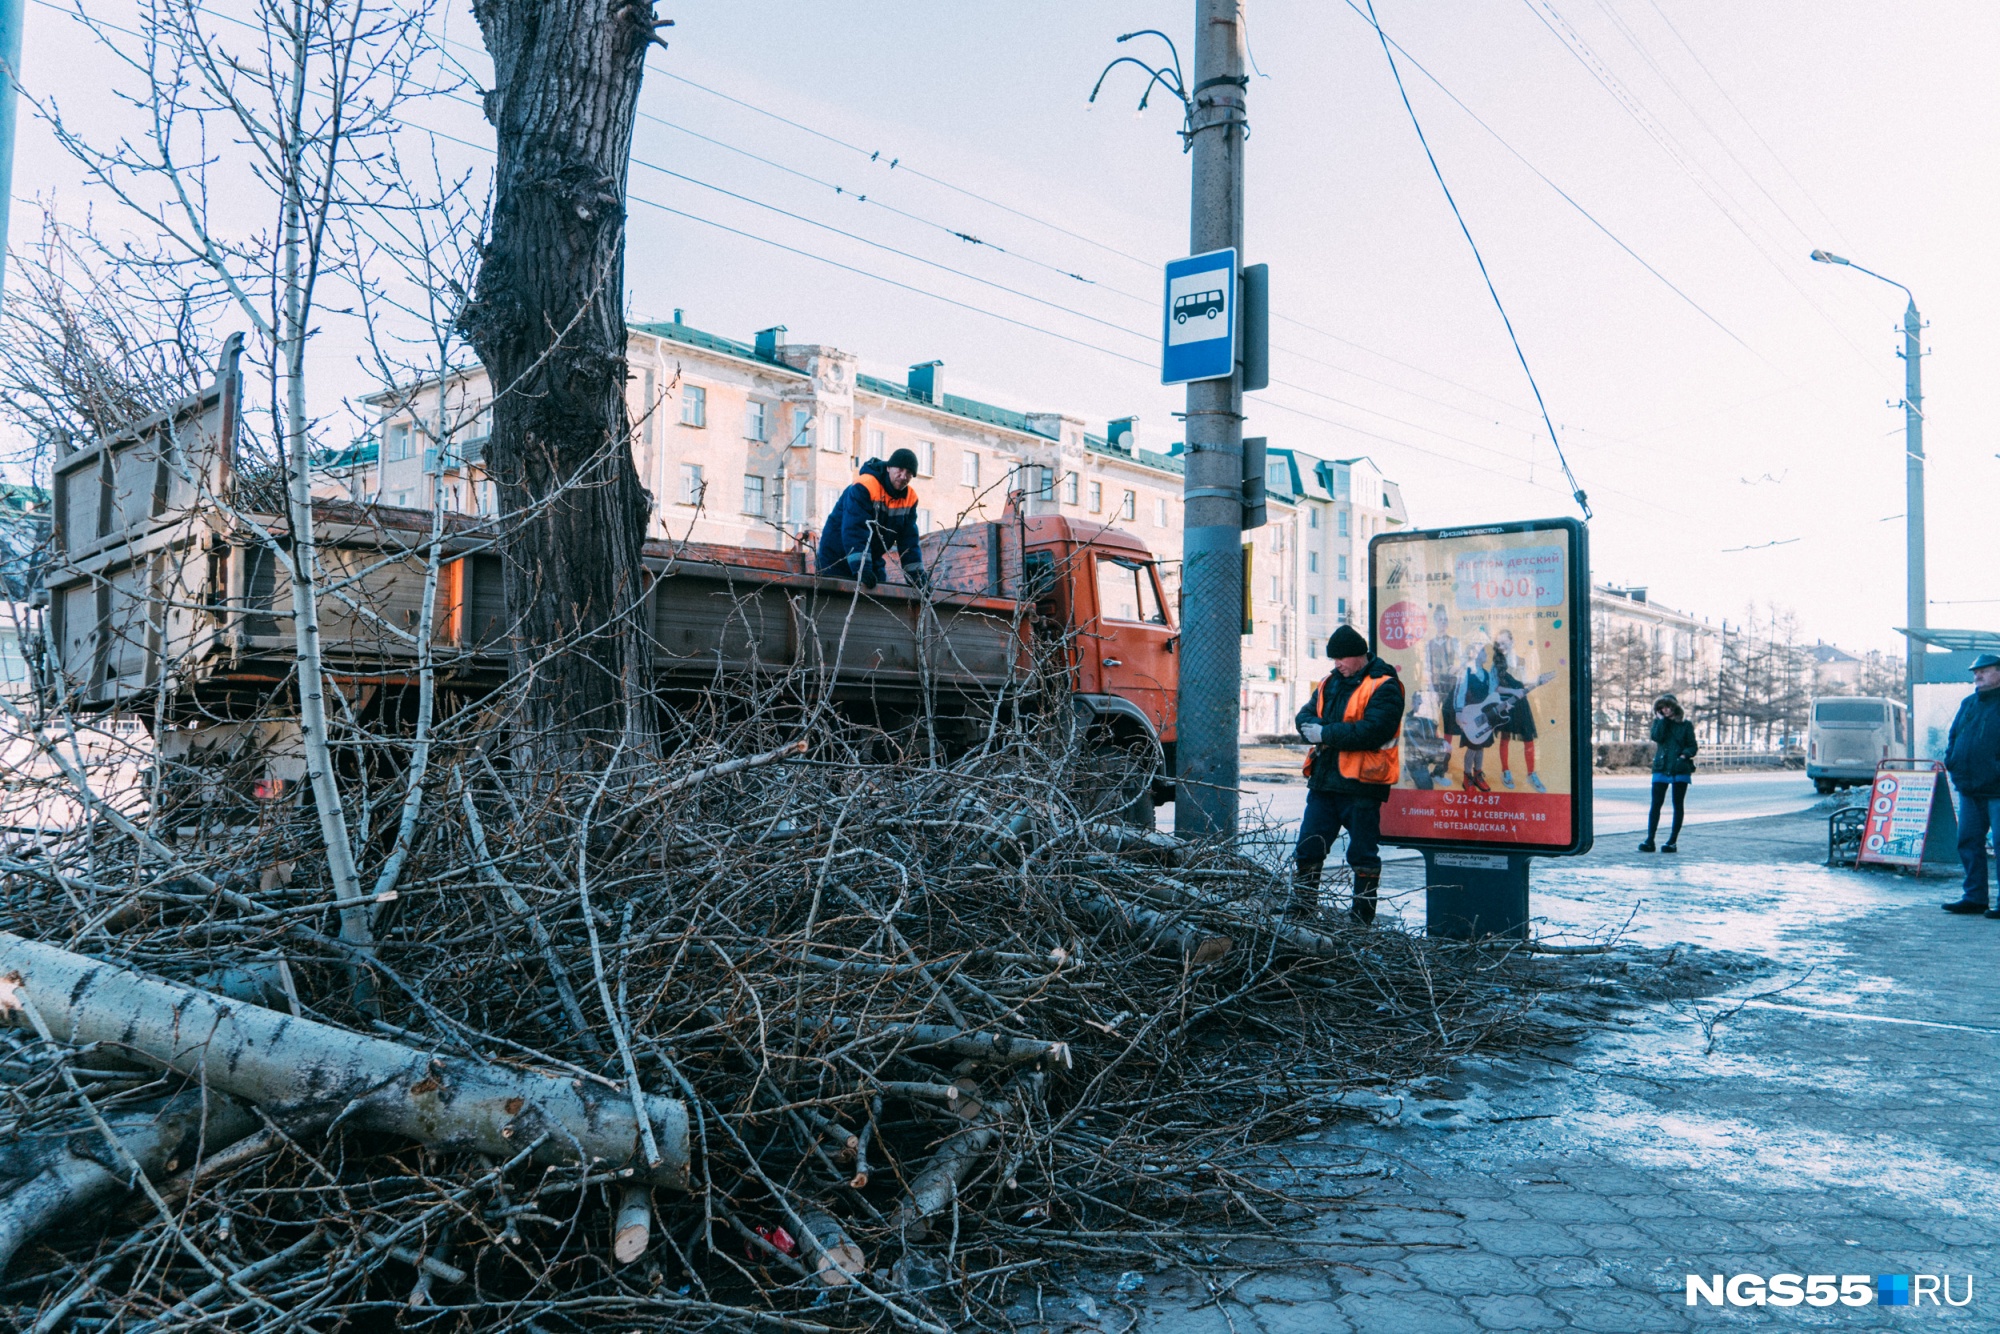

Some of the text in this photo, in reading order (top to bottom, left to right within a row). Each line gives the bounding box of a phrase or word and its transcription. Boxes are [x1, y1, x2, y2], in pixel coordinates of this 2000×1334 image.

[1457, 552, 1560, 570] Костюм детский
[1471, 577, 1531, 600] 1000
[1535, 586, 1551, 598] р.
[1385, 626, 1424, 640] 2020
[1456, 794, 1501, 805] 22-42-87
[1408, 808, 1438, 817] ЛИНИЯ,
[1472, 810, 1482, 819] 24
[1484, 810, 1528, 821] СЕВЕРНАЯ,
[1531, 813, 1546, 822] 188
[1866, 778, 1898, 851] ФОТО
[1433, 821, 1517, 833] НЕФТЕЗАВОДСКАЯ, 4
